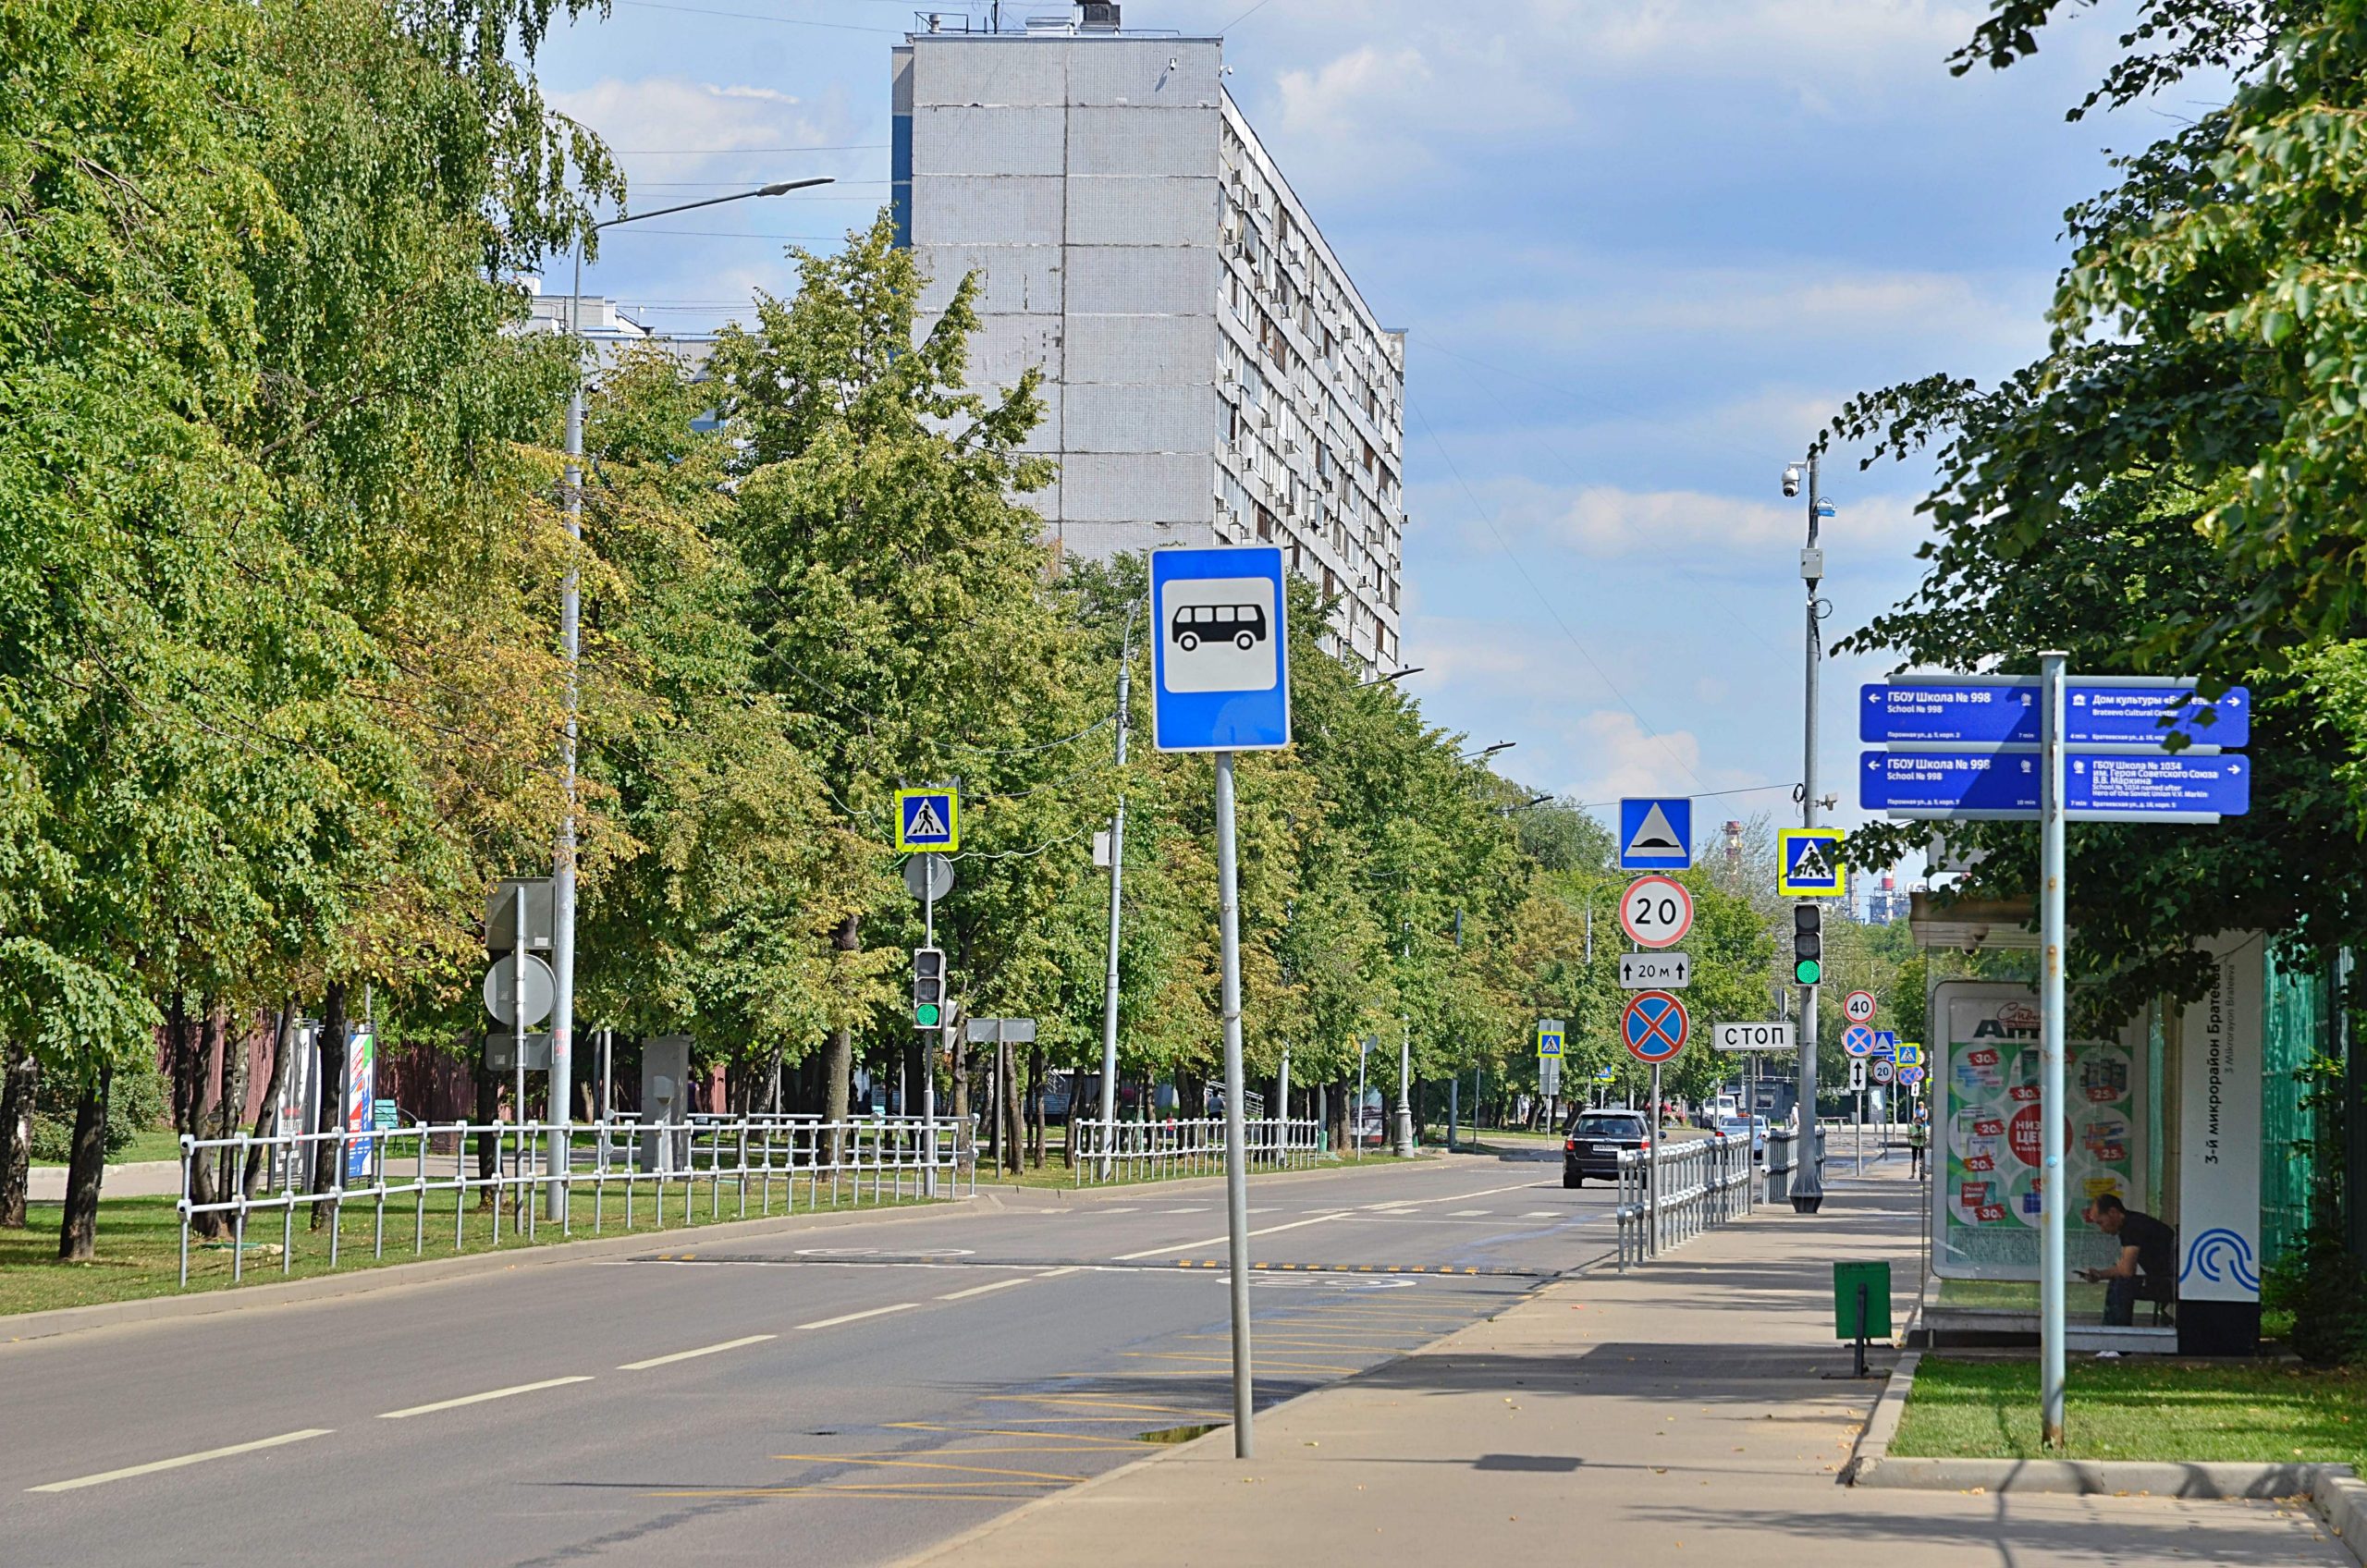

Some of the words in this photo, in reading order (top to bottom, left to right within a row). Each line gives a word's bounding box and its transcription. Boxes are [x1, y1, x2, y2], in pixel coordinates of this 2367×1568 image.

[1887, 692, 1915, 703] ГБОУ
[1916, 692, 1954, 703] Школа
[1956, 692, 1968, 703] №
[1970, 692, 1992, 704] 998
[2092, 695, 2115, 705] Дом
[2116, 696, 2162, 706] культуры
[1887, 704, 1915, 714] School
[1927, 705, 1944, 714] 998
[2153, 709, 2178, 717] Center
[1887, 759, 1915, 769] ГБОУ
[1916, 759, 1954, 769] Школа
[1956, 759, 1968, 769] №
[1970, 759, 1991, 770] 998
[2092, 761, 2115, 770] ГБОУ
[2116, 761, 2146, 770] Школа
[2148, 762, 2159, 770] №
[2160, 762, 2182, 770] 1034
[1887, 772, 1915, 780] School
[1927, 772, 1944, 780] 998
[2110, 769, 2137, 778] Героя
[2138, 769, 2188, 779] Советского
[2189, 770, 2219, 779] Союза
[2110, 778, 2152, 786] Маркина
[1635, 898, 1676, 925] 20
[1638, 964, 1655, 977] 20
[1659, 969, 1670, 977] м
[2224, 964, 2235, 1007] Brateeva
[1850, 1001, 1870, 1013] 40
[1724, 1027, 1784, 1045] СТОП
[2224, 1009, 2237, 1065] Mikrorayon
[1877, 1067, 1889, 1076] 20
[2206, 1039, 2223, 1135] микрорайон
[2205, 1139, 2219, 1165] 3-й
